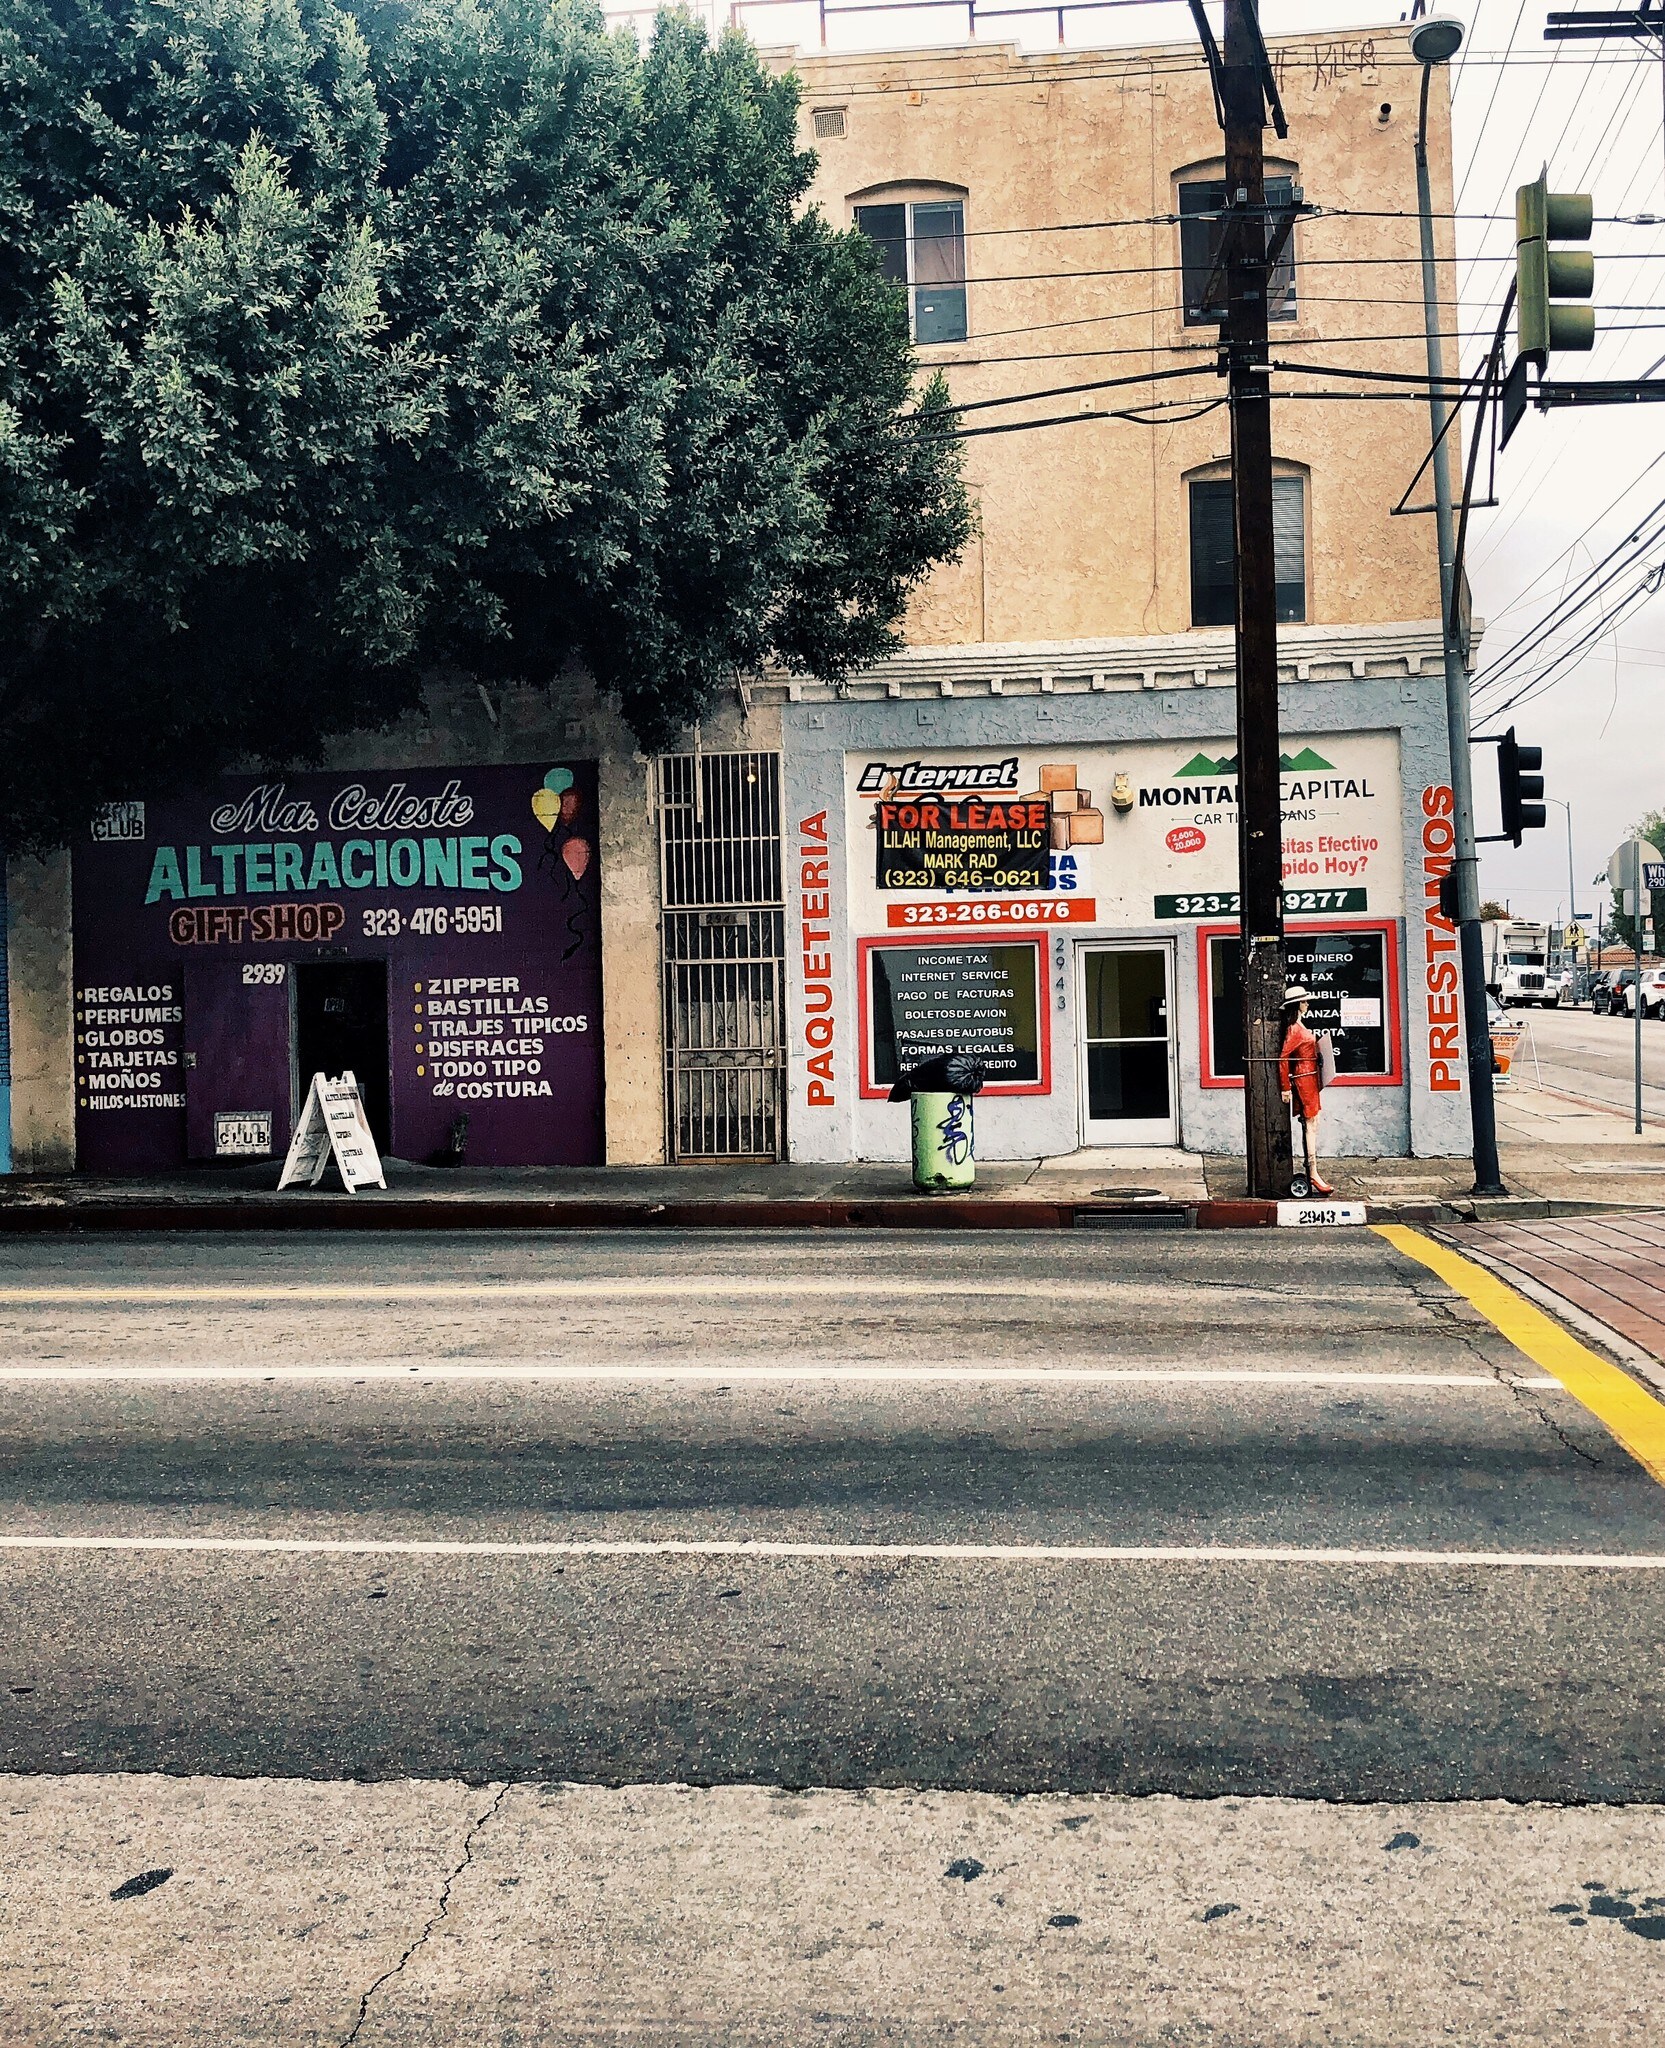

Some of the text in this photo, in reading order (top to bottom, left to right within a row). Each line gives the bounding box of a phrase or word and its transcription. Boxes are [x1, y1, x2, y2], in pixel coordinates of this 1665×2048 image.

[857, 757, 1018, 791] Internet
[329, 780, 474, 830] Celeste
[1139, 785, 1239, 807] MONTA
[881, 803, 1047, 830] FOR LEASE
[1194, 813, 1222, 825] CAR
[93, 820, 144, 838] CLUB
[883, 830, 1042, 852] LILAH Management, LLC
[1318, 835, 1378, 853] Efectivo
[144, 834, 523, 905] ALTERACIONES
[924, 853, 998, 869] MARK RAD
[1325, 856, 1368, 876] Hoy?
[885, 869, 936, 888] (323)
[944, 869, 1040, 886] 646-0621
[904, 901, 1070, 923] 323-266-0676
[169, 902, 345, 945] GIFT SHOP
[1422, 784, 1461, 1092] PRESTAMOS
[800, 809, 836, 1107] PAQUETERIA
[917, 955, 988, 966] INCOME TAX
[1288, 953, 1353, 963] DE DINERO
[242, 964, 285, 985] 2939
[901, 971, 1009, 982] INTERNET SERVICE
[1311, 973, 1333, 981] FAX
[84, 985, 173, 1003] REGALOS
[428, 977, 520, 995] ZIPPER
[897, 989, 1014, 1001] PAGO DE FACTURAS
[427, 997, 549, 1016] BASTILLAS
[905, 1009, 1007, 1020] BOLETOS DE AVION
[85, 1007, 182, 1025] PERFUMES
[429, 1015, 588, 1037] TRAJES TIPICOS
[896, 1027, 1014, 1040] PASAJES DE AUTOBUS
[85, 1029, 164, 1047] GLOBOS
[428, 1038, 544, 1057] DISFRACES
[901, 1043, 1014, 1055] FORMAS LEGALES
[88, 1051, 178, 1068] TARJETAS
[430, 1059, 541, 1078] TODO TIPO
[89, 1069, 162, 1089] MOÑOS
[432, 1079, 553, 1099] de COSTURA
[220, 1132, 267, 1144] CLUB
[1300, 1210, 1336, 1224] 2943
